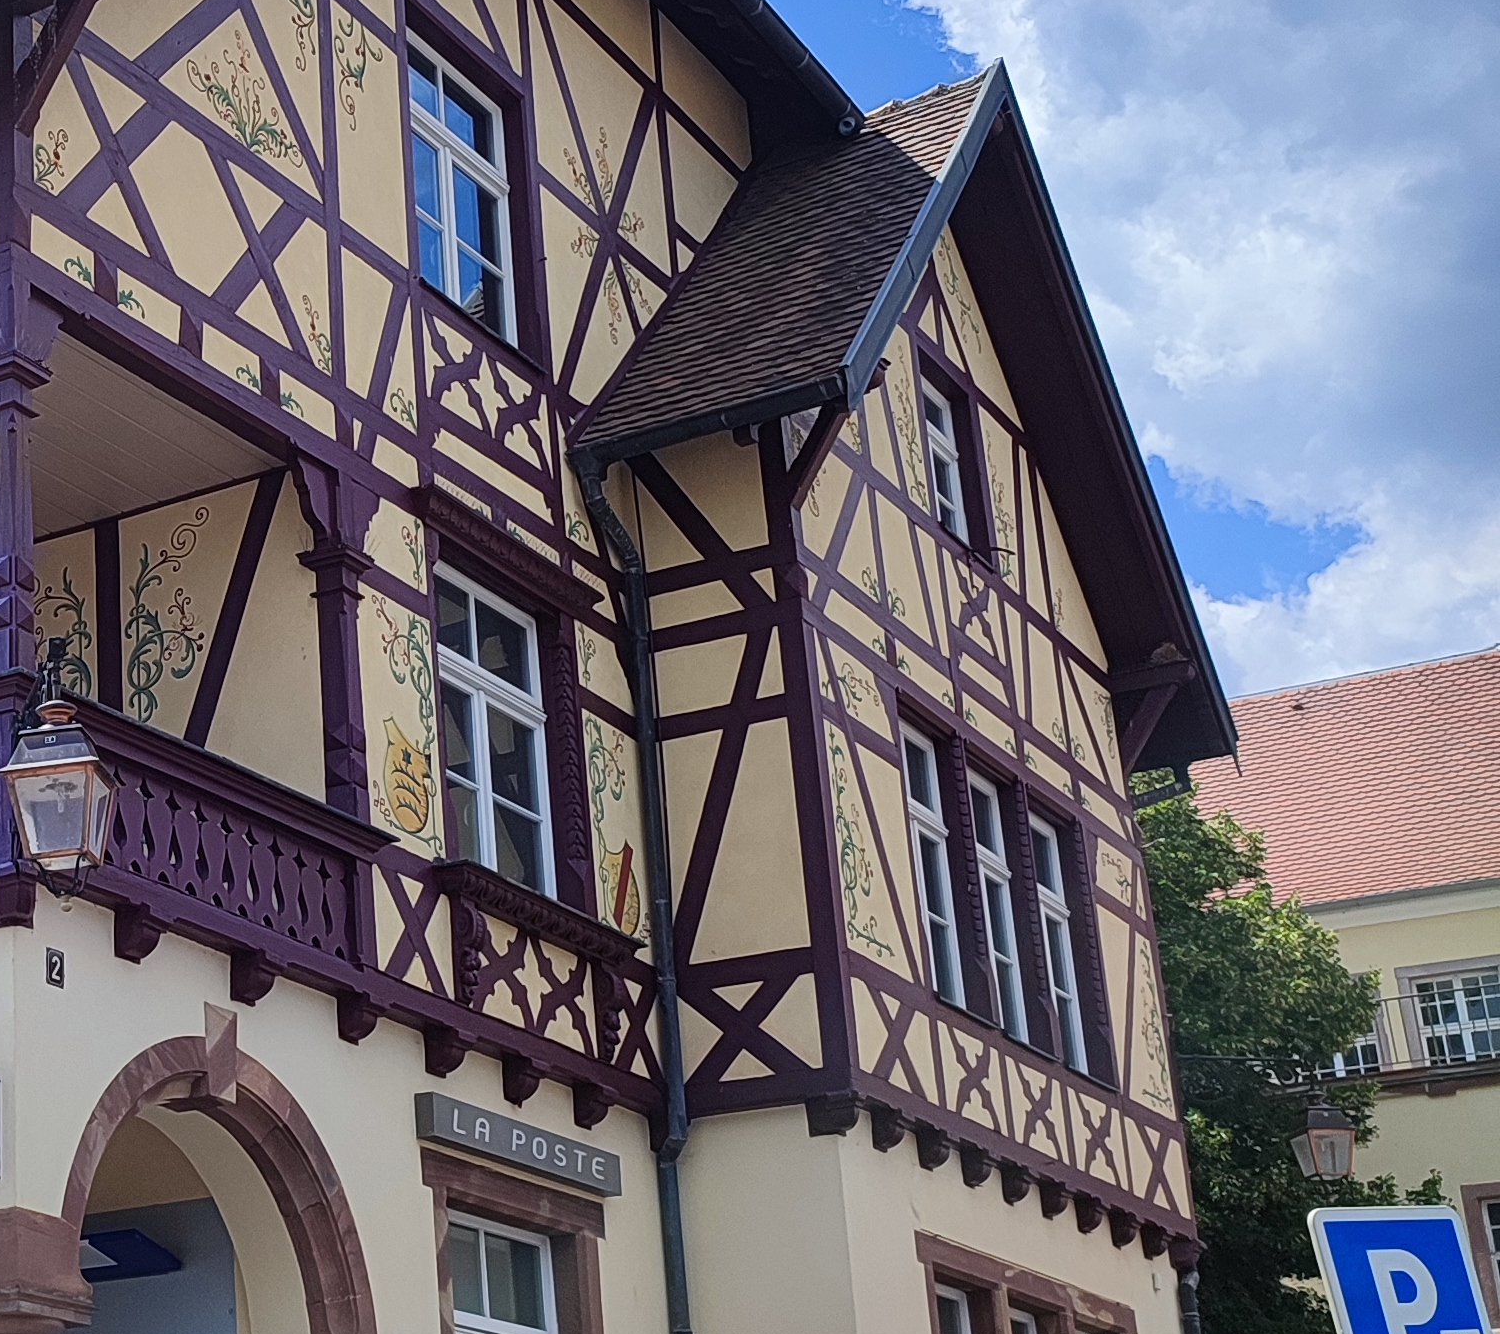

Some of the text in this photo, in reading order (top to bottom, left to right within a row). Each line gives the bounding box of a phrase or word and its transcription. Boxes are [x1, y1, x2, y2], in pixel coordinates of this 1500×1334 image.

[51, 955, 61, 981] 2
[452, 1107, 606, 1181] LA POSTE
